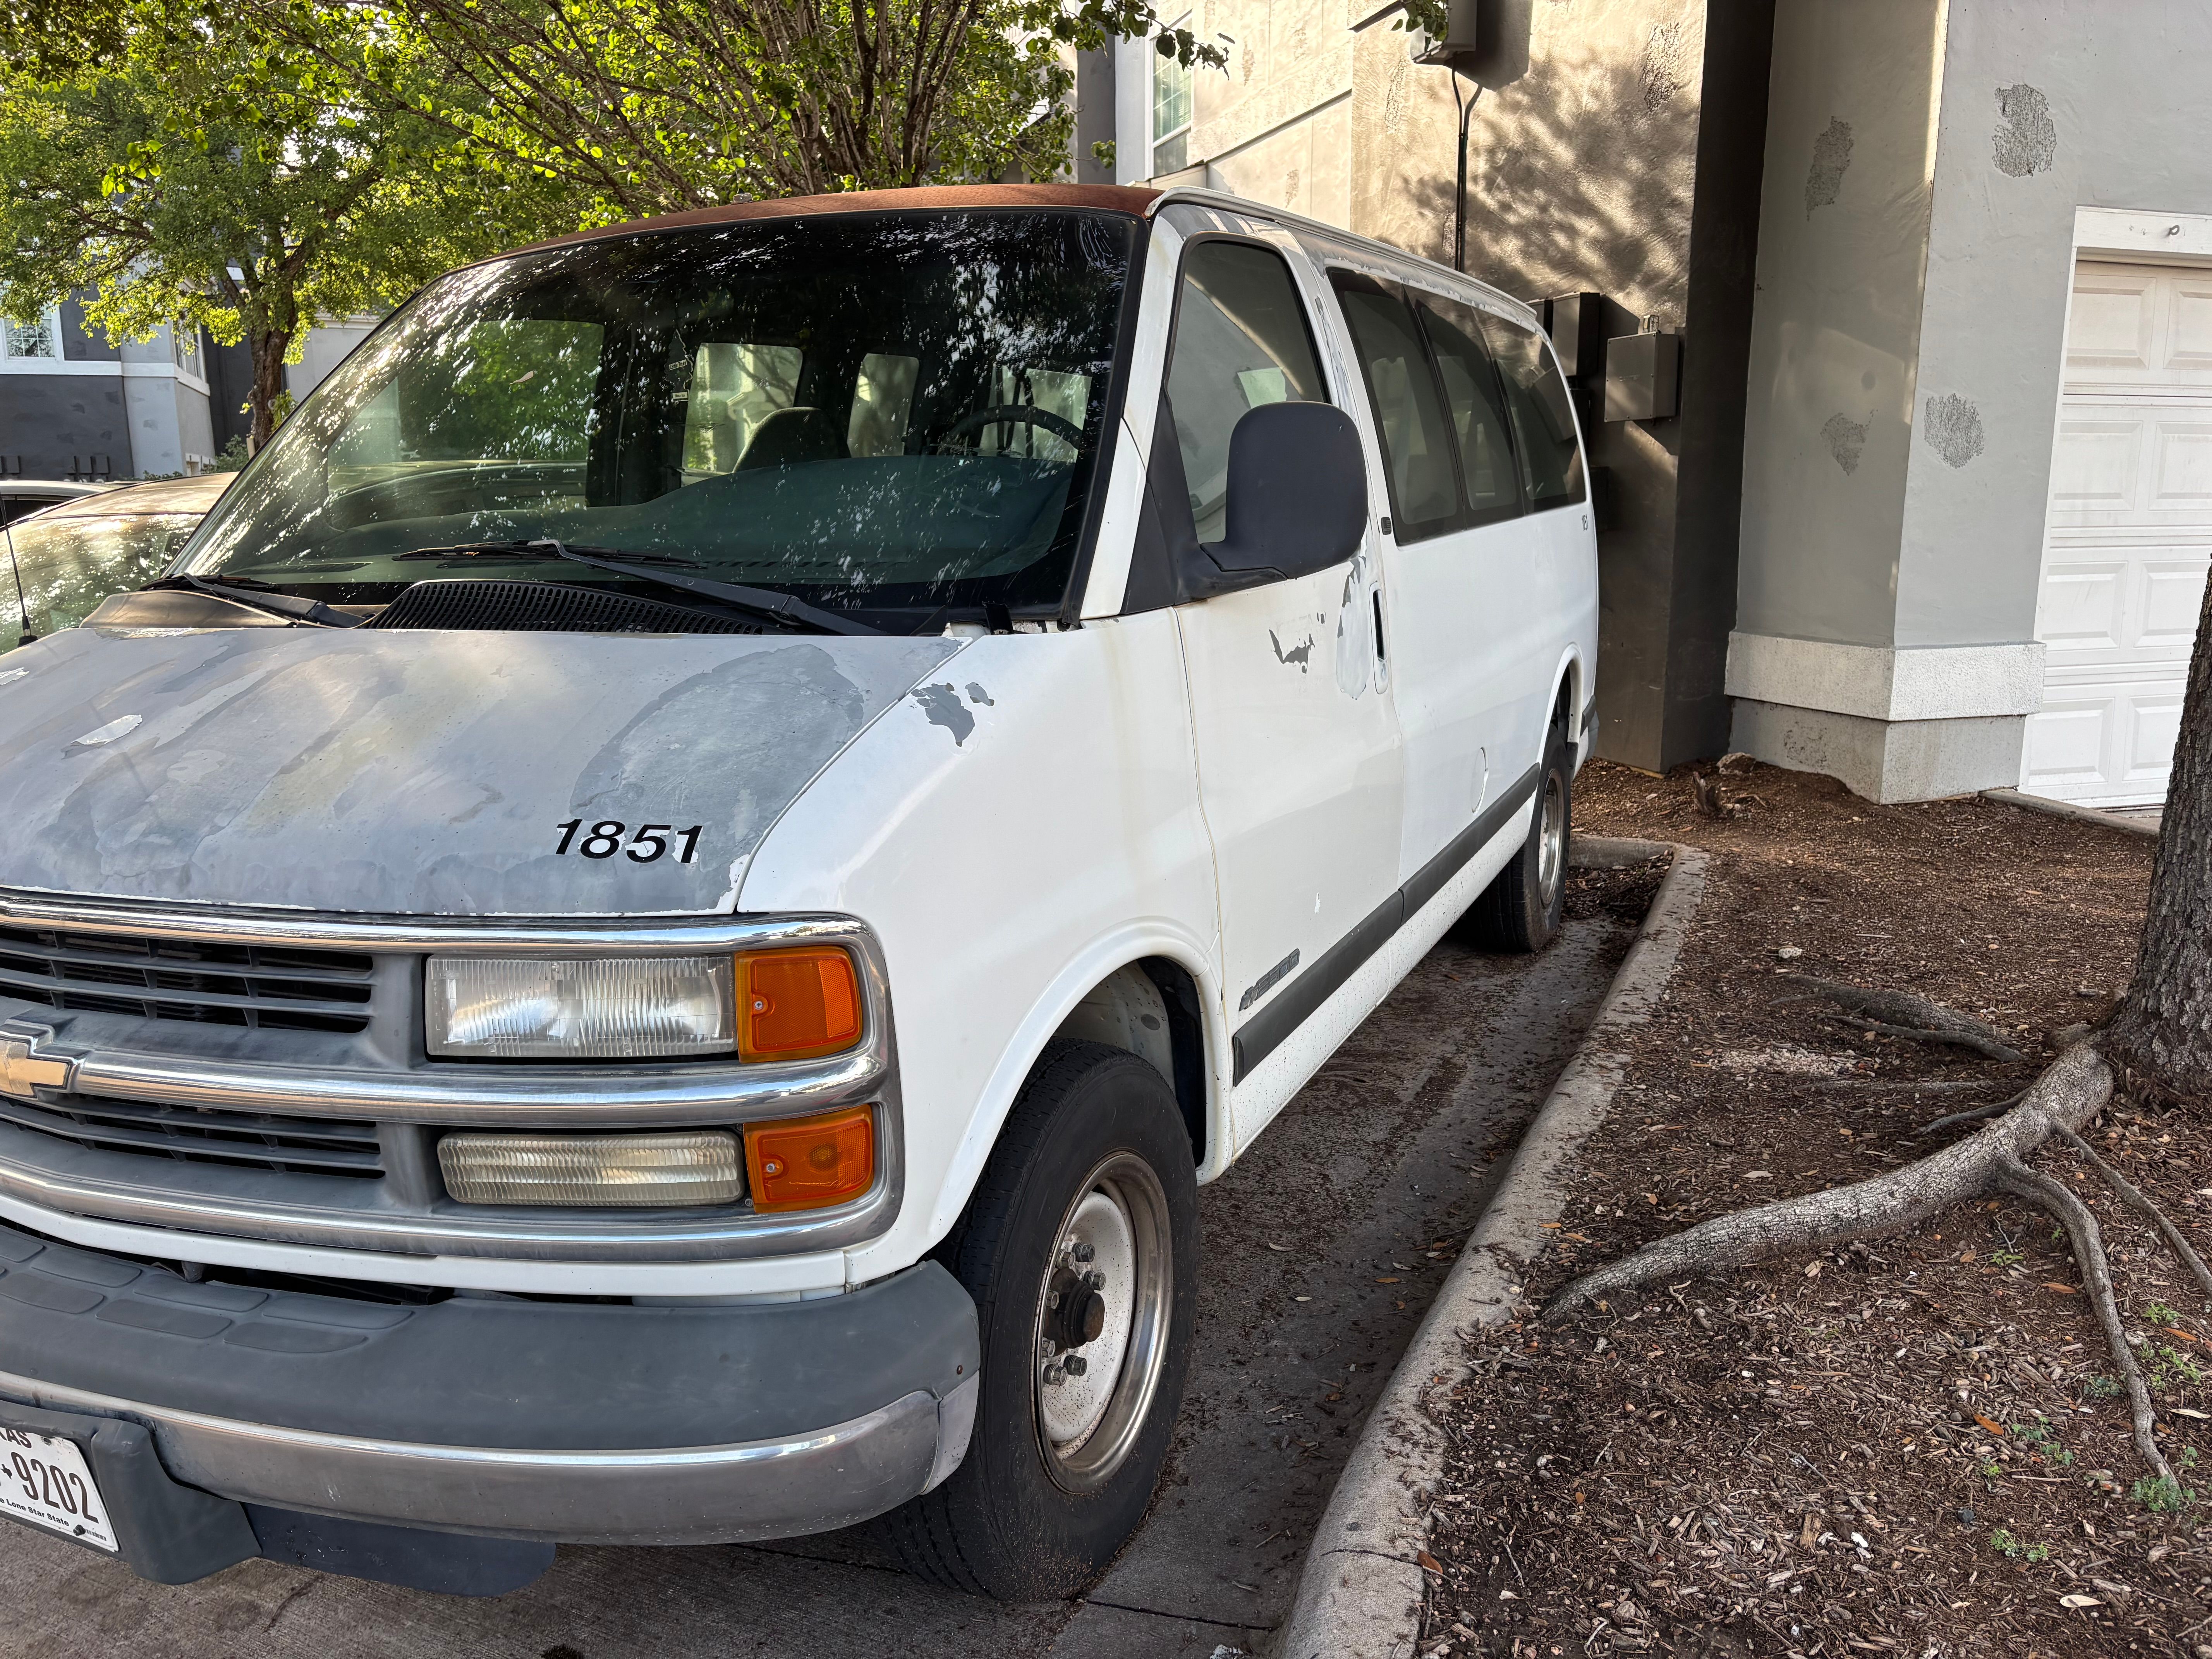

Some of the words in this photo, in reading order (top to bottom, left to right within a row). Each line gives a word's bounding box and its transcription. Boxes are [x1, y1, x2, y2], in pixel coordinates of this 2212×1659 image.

[555, 819, 703, 864] 1851
[11, 1452, 99, 1523] 9202
[6, 1499, 26, 1511] Lone
[27, 1506, 45, 1517] Star
[47, 1513, 69, 1527] State
